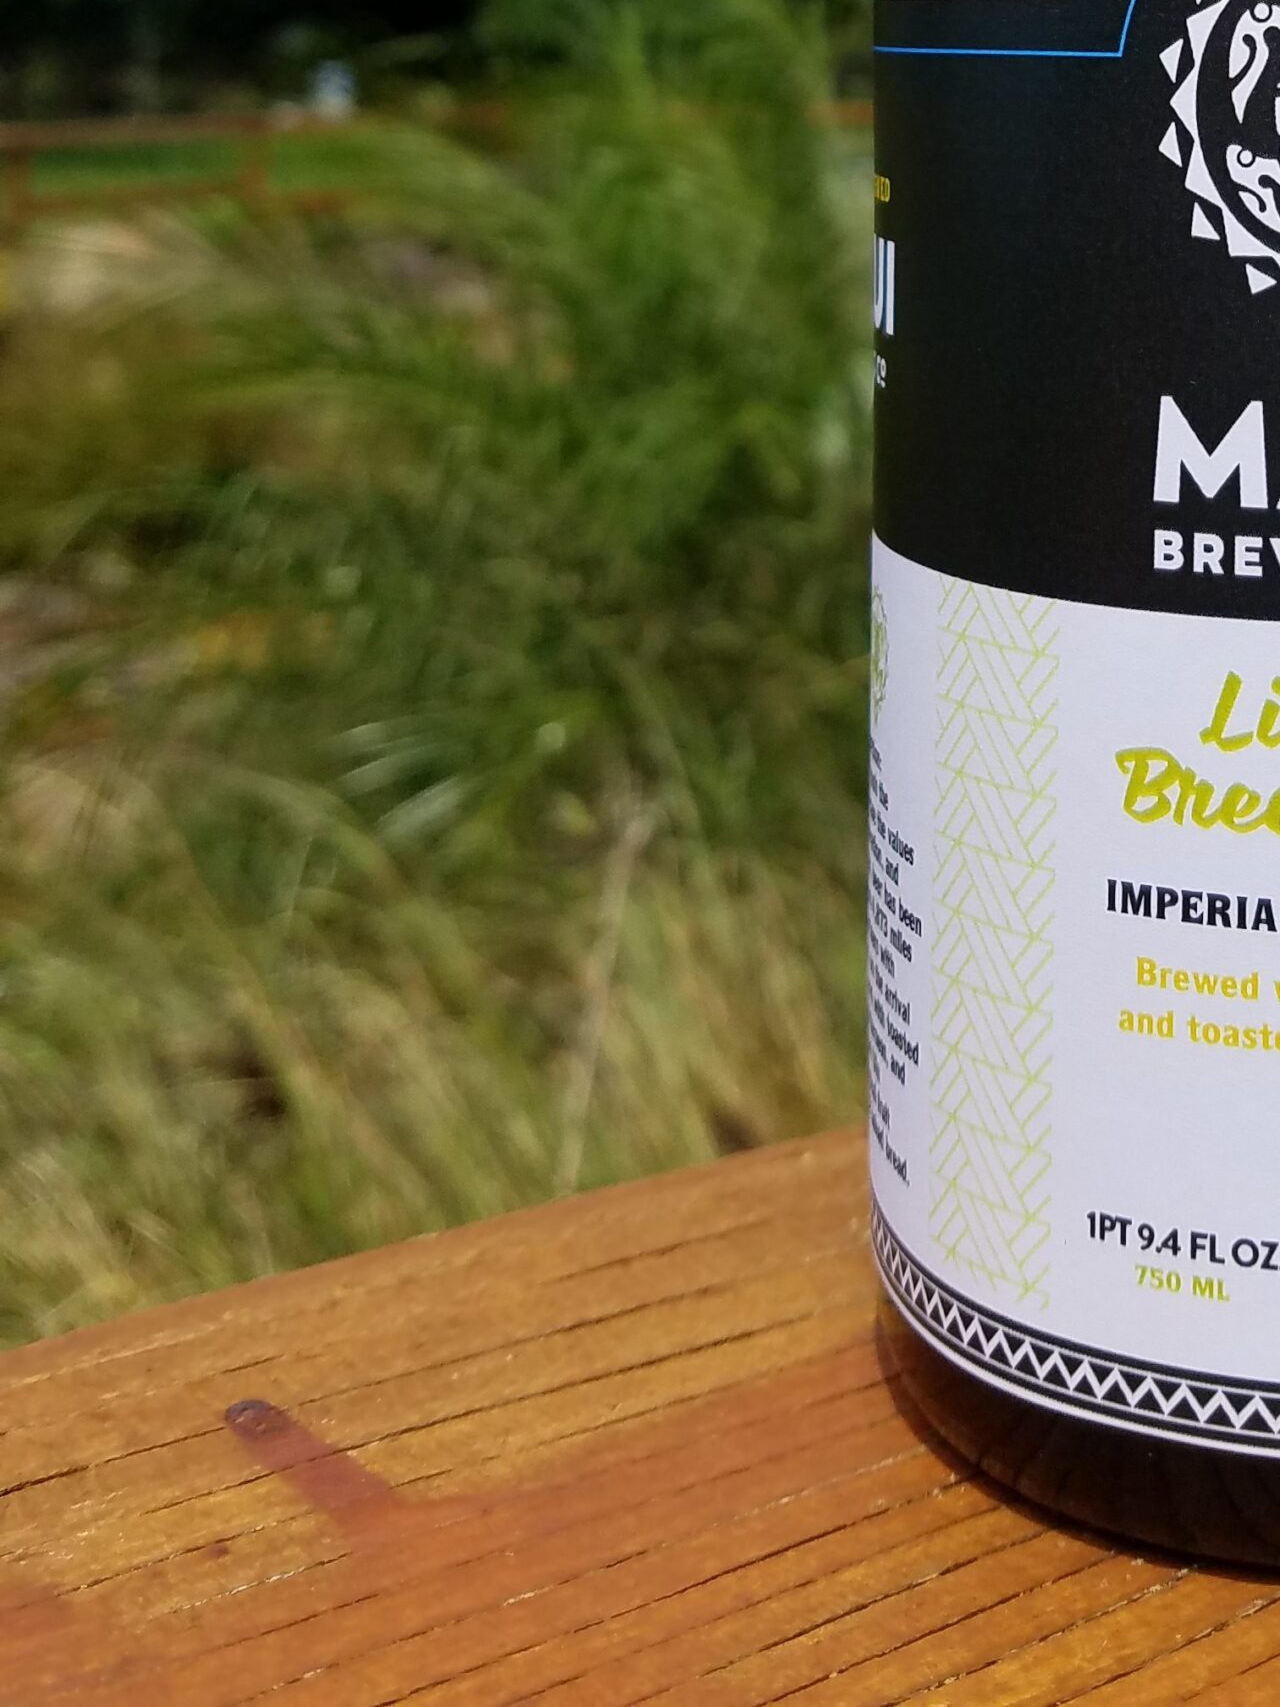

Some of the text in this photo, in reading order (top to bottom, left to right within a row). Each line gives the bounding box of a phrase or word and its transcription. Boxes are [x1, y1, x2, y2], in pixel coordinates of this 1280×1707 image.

[888, 826, 914, 866] values
[886, 856, 899, 886] and
[884, 881, 896, 915] has
[899, 897, 922, 938] been
[890, 925, 912, 963] miles
[1135, 956, 1260, 1001] Brewed
[885, 984, 911, 1025] arrival
[1118, 1006, 1175, 1040] and
[887, 1013, 919, 1065] toasted
[891, 1054, 905, 1085] and
[1086, 1210, 1132, 1247] 1PT
[1138, 1223, 1182, 1257] 9.4
[1190, 1231, 1226, 1265] FL
[1135, 1264, 1231, 1302] 750 ML
